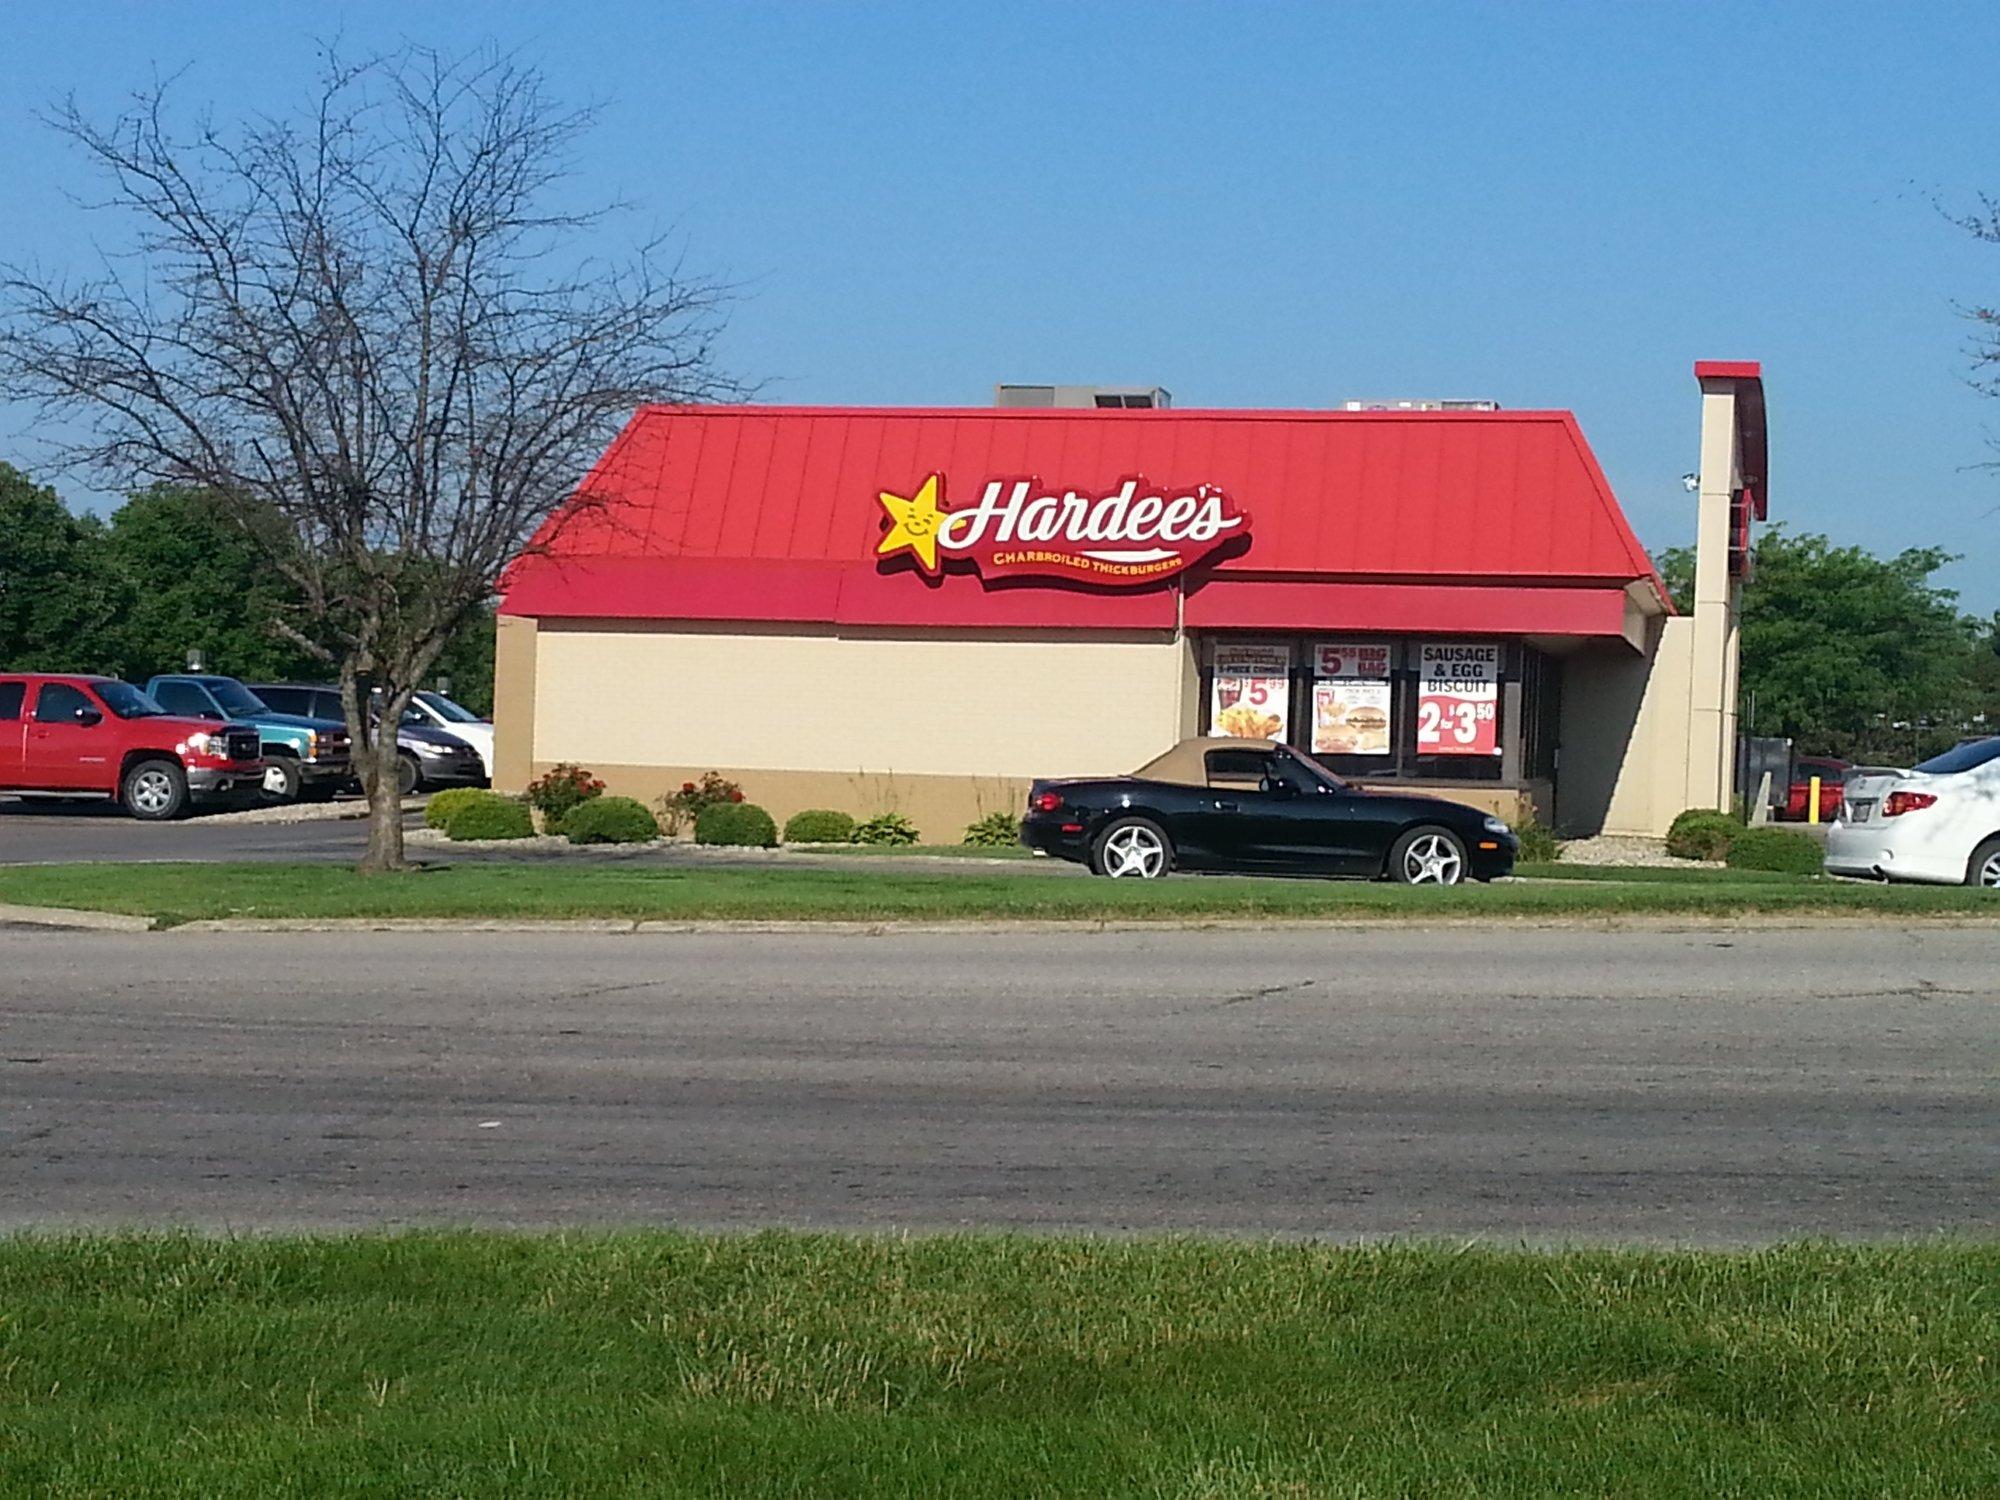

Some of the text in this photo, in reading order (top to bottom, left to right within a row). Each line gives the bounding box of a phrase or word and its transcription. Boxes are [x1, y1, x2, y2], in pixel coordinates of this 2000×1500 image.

[937, 481, 1242, 549] Hardee's
[993, 551, 1182, 575] CHARBROILED THICKBURGERS
[1424, 647, 1496, 662] SAUSAGE
[1434, 663, 1483, 677] & EGG
[1427, 679, 1488, 693] BISCUIT
[1418, 701, 1441, 743] 2
